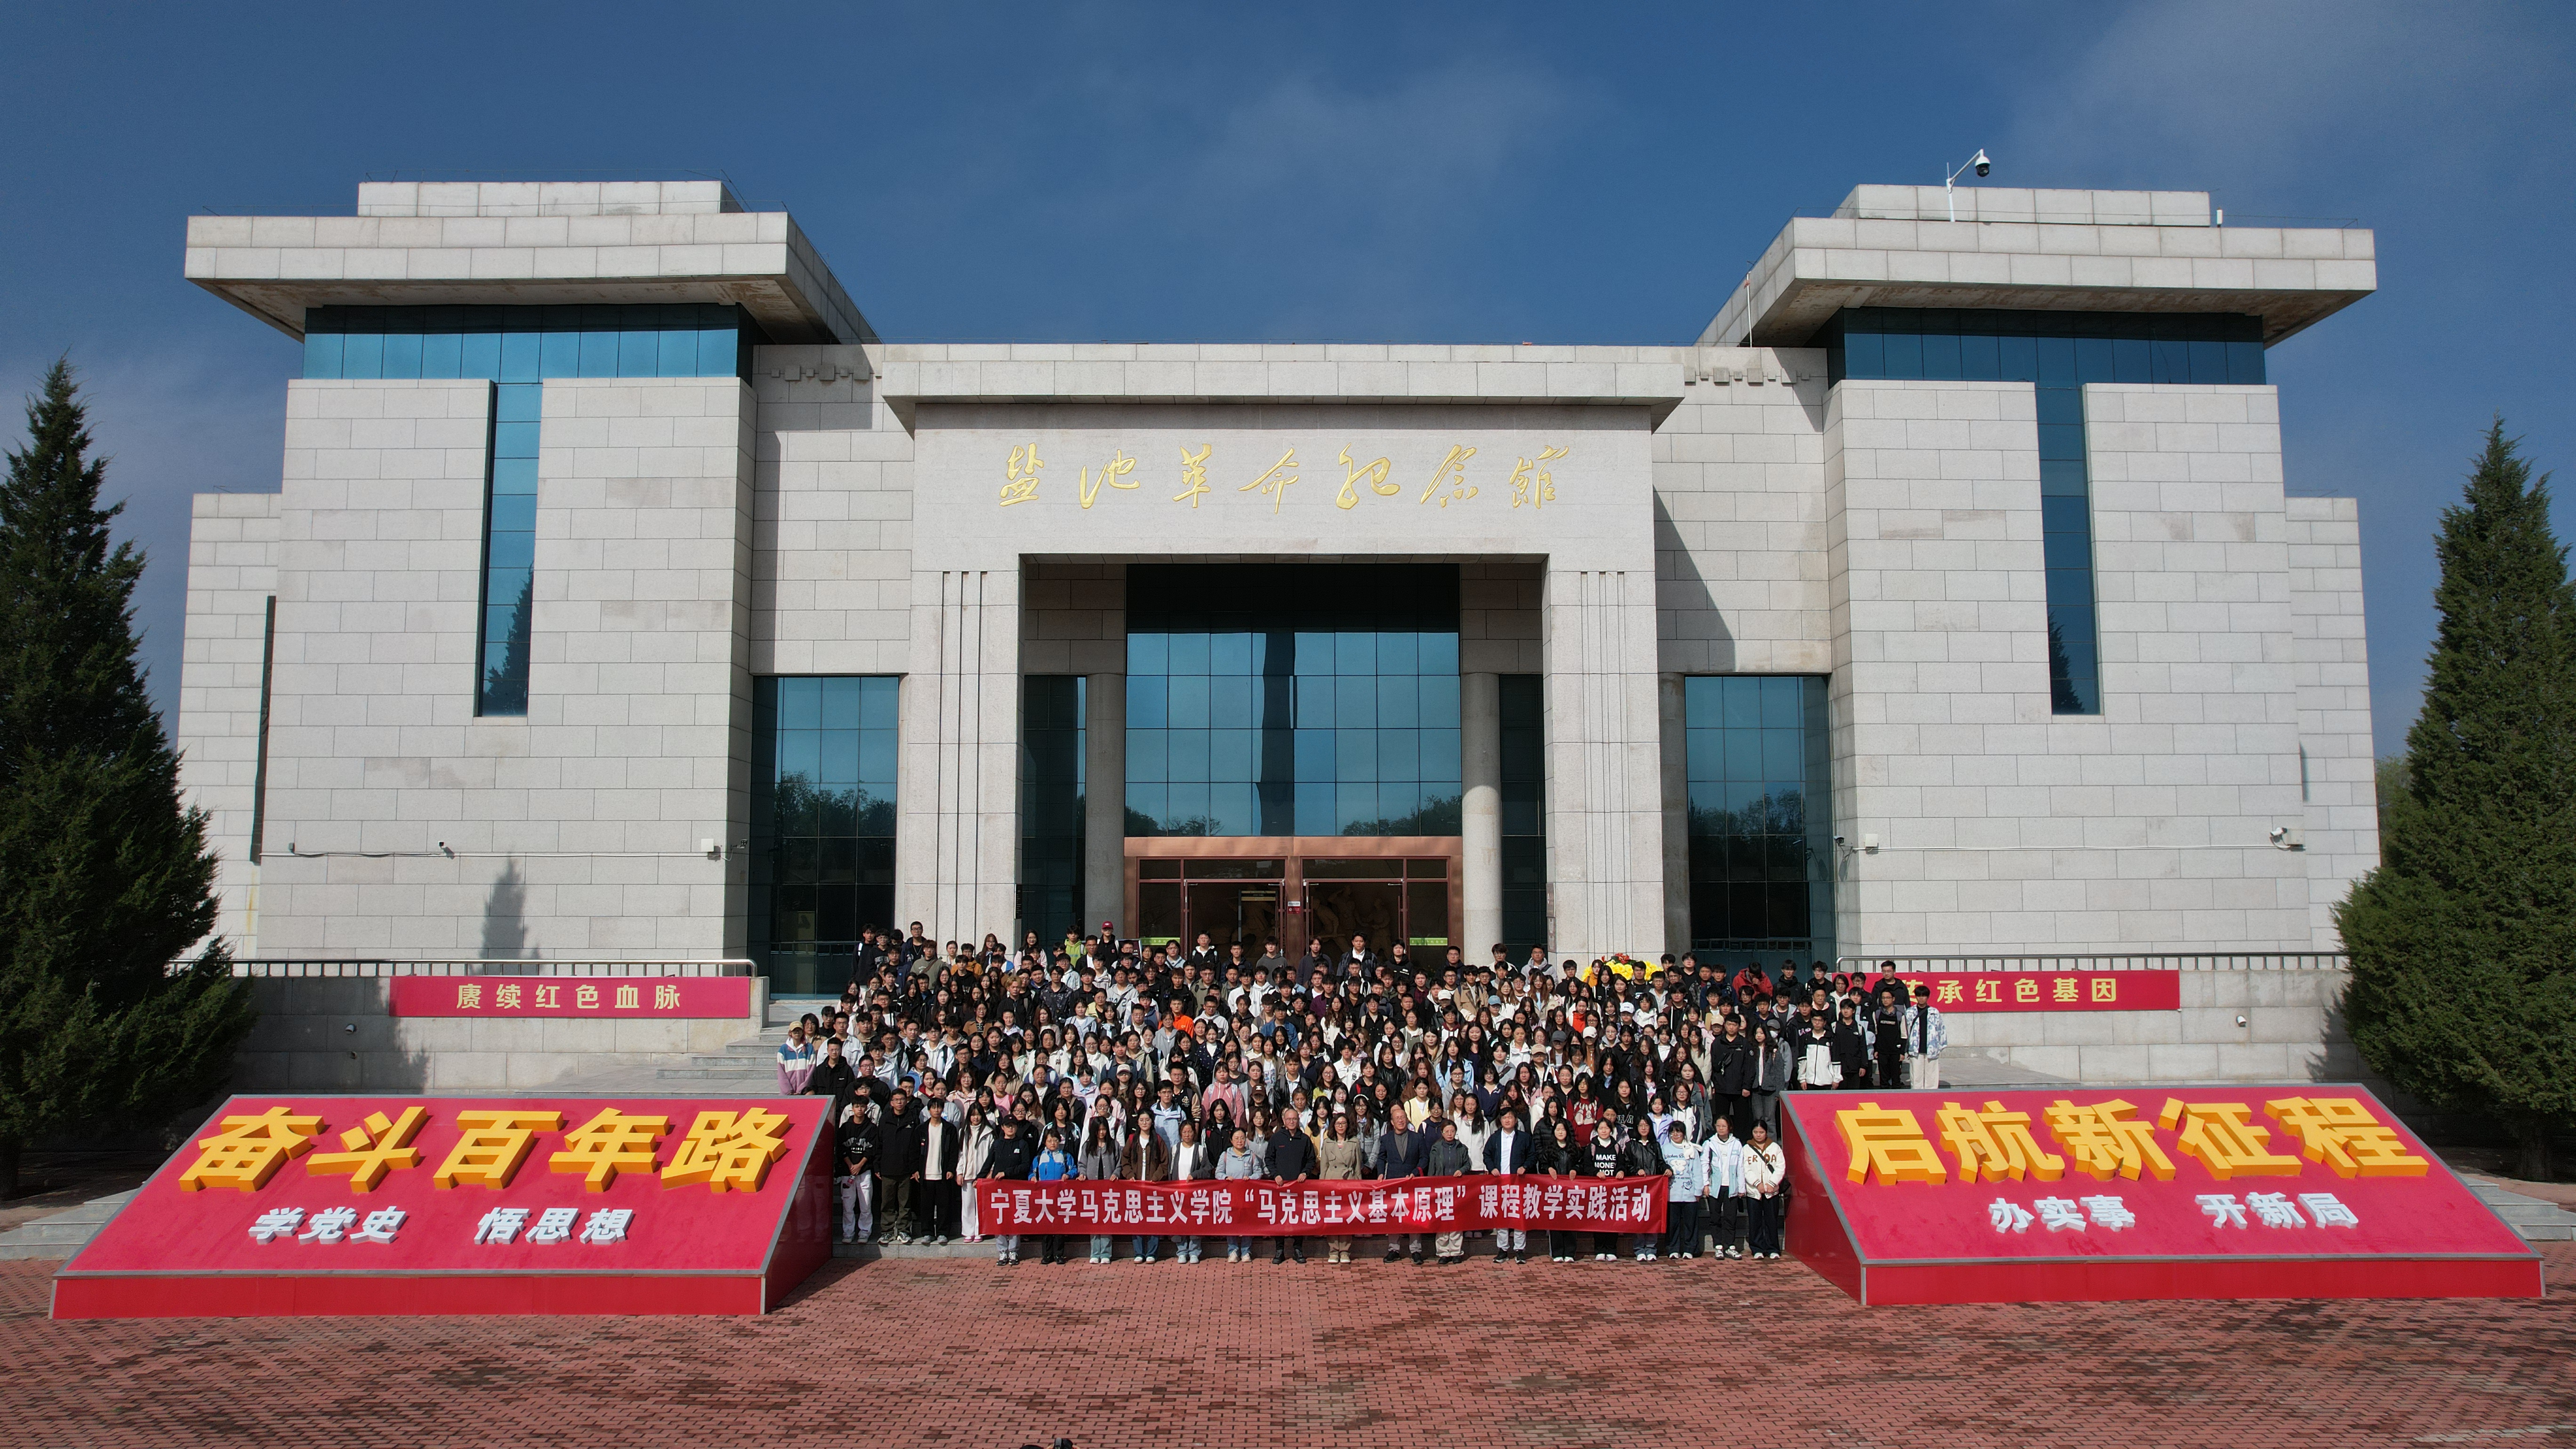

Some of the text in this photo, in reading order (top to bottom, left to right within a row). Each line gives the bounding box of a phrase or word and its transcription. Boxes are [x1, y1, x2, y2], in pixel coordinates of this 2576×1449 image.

[457, 984, 680, 1009] 赓续红色血脉
[179, 1106, 789, 1193] 奋斗百年路
[1835, 1097, 2429, 1185] 启航新征程
[248, 1206, 633, 1246] 学党史 悟思想
[1988, 1192, 2359, 1234] 办实事 开新局
